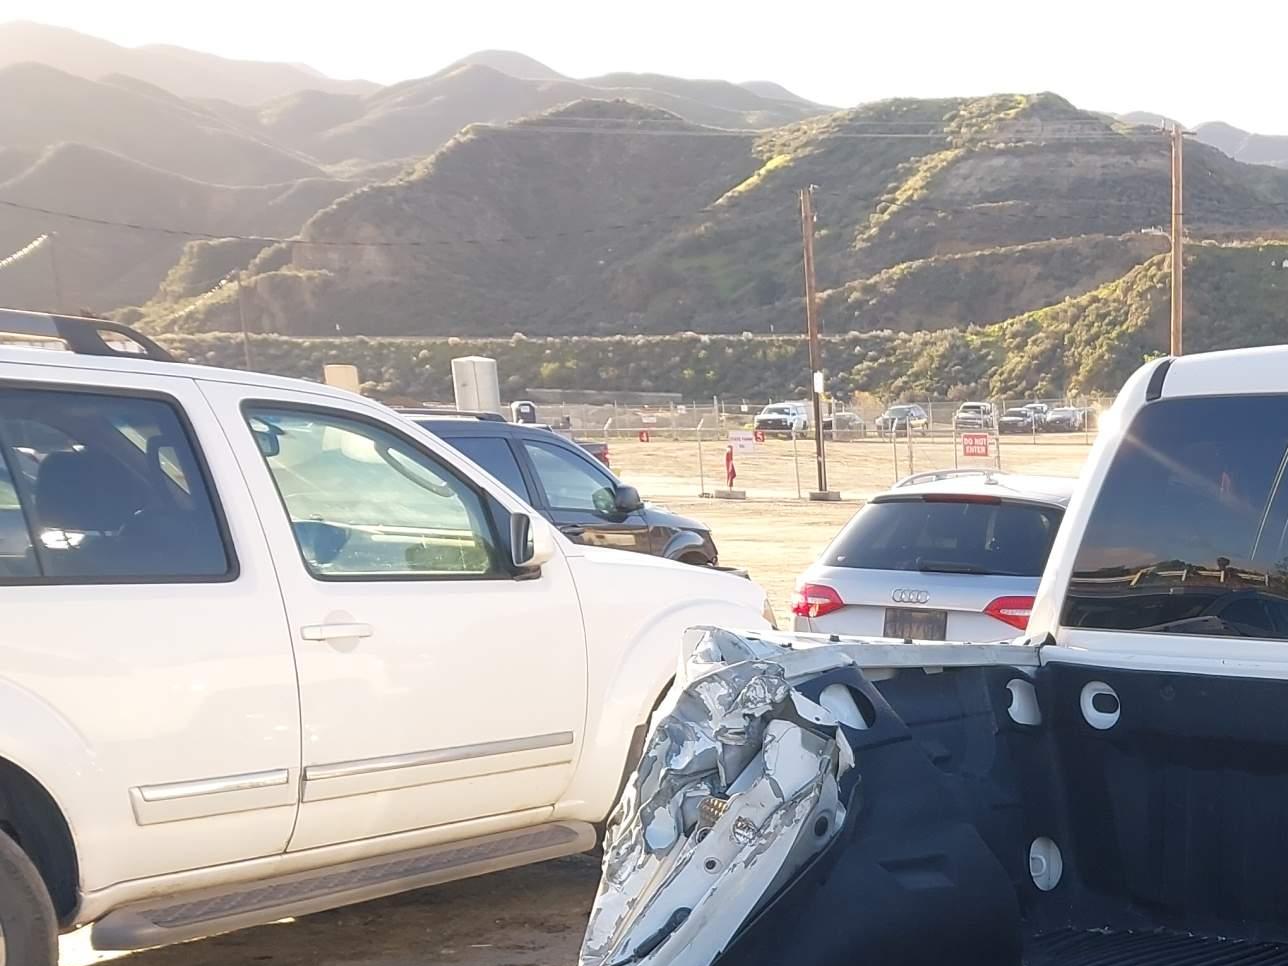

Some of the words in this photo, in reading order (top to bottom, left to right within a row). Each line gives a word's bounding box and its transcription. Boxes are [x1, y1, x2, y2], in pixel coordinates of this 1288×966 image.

[963, 437, 973, 446] DO
[974, 437, 986, 446] NOT
[965, 446, 986, 454] ENTER
